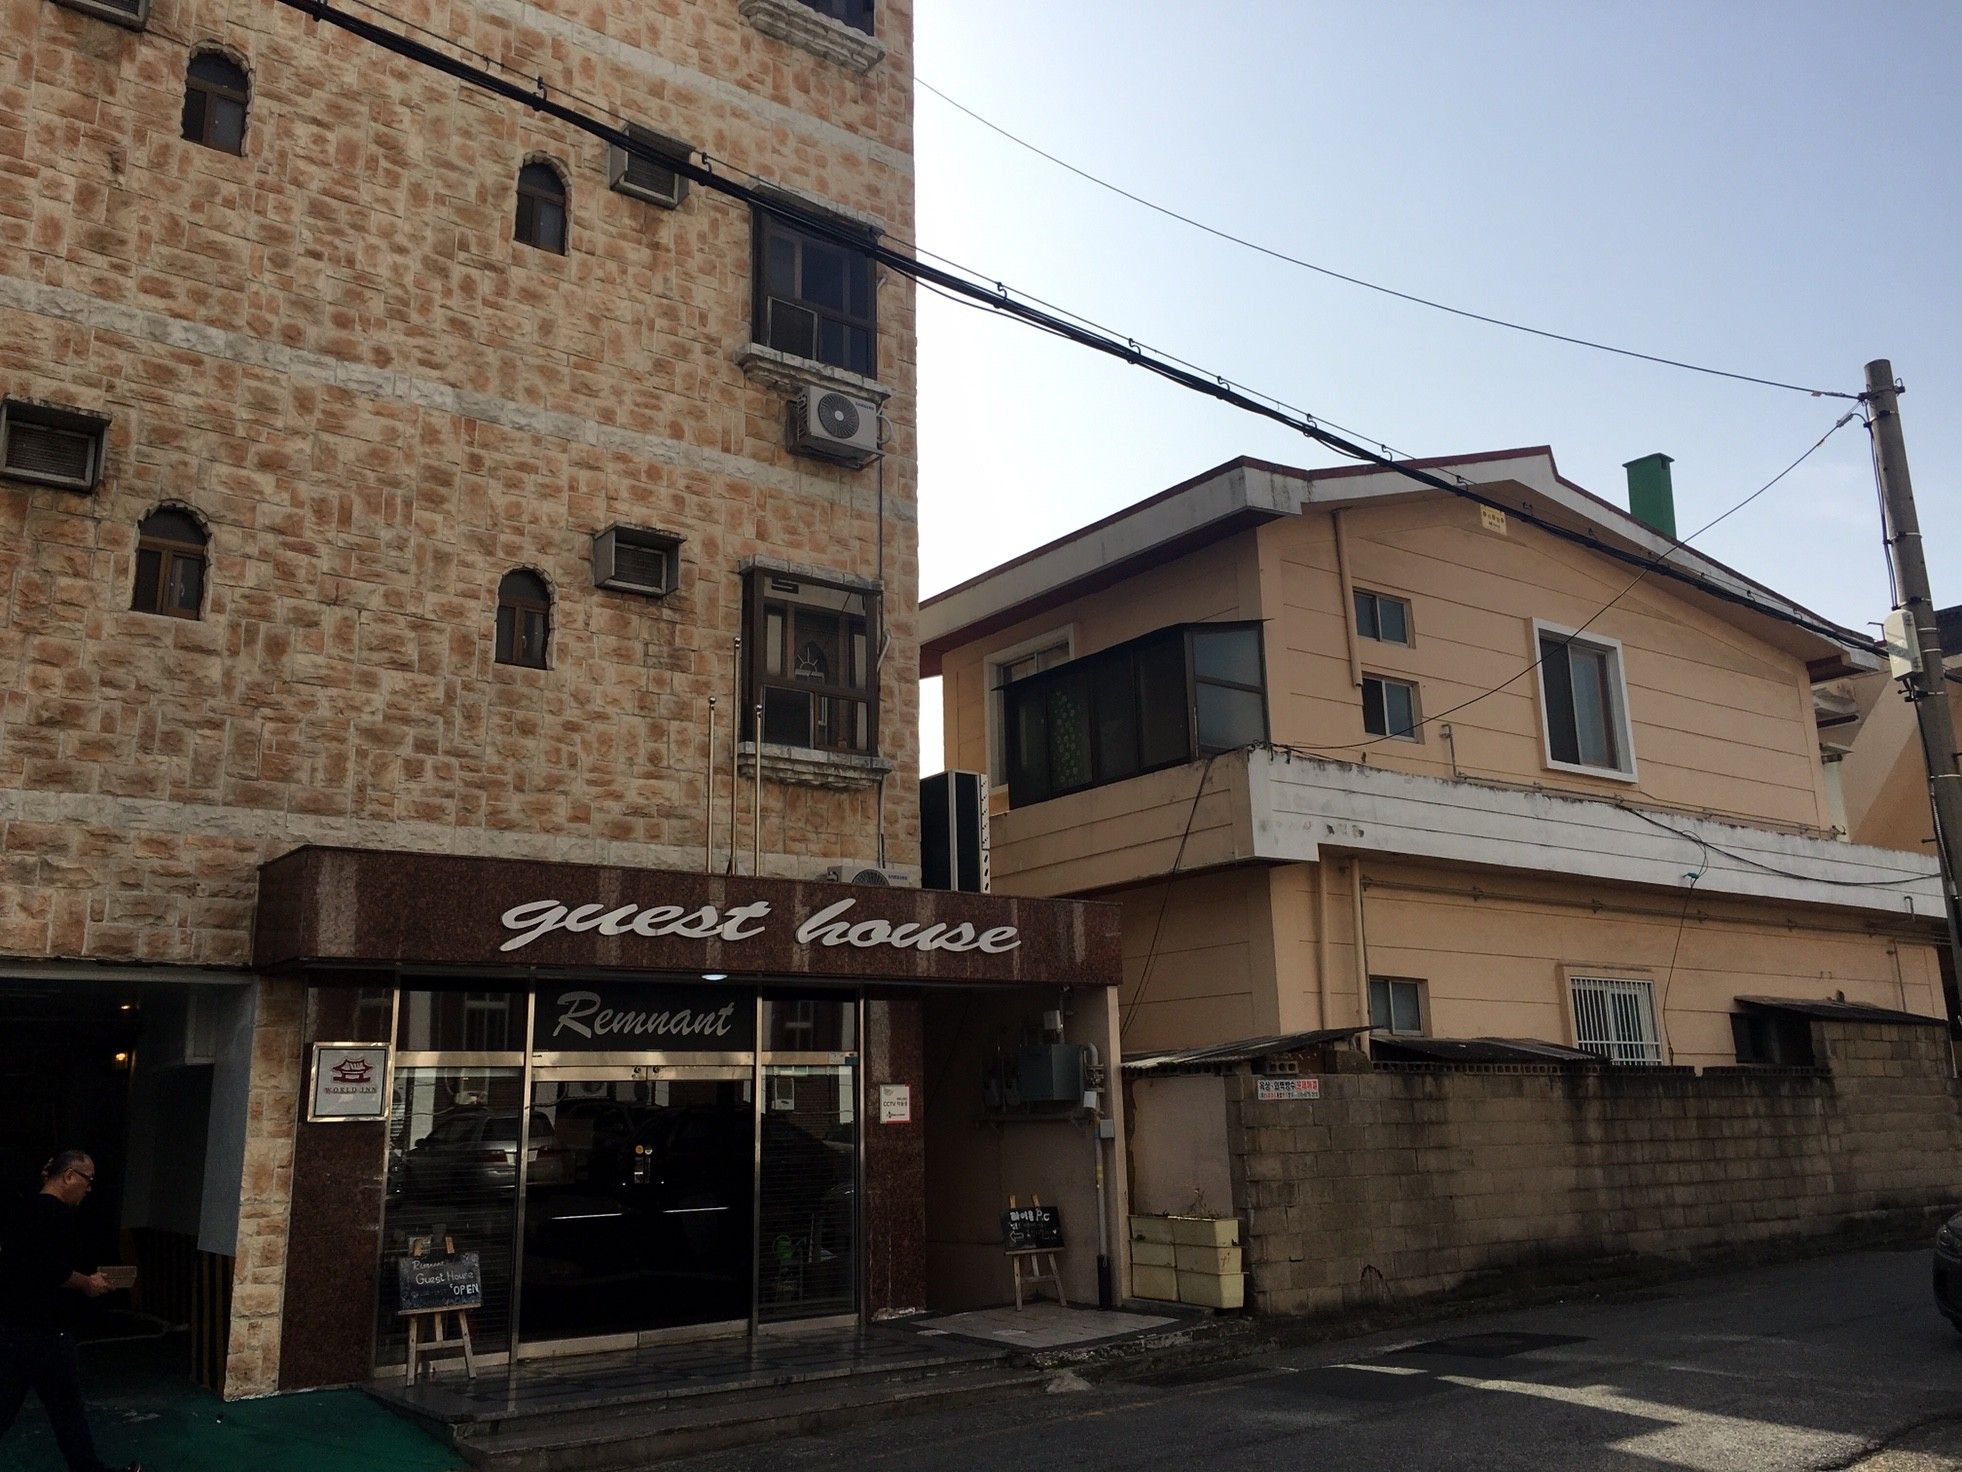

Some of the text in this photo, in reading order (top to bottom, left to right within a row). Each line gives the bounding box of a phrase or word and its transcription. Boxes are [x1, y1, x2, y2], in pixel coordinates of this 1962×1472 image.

[500, 898, 1021, 954] guest house
[553, 991, 734, 1038] Remnant
[416, 1271, 473, 1284] Guest House
